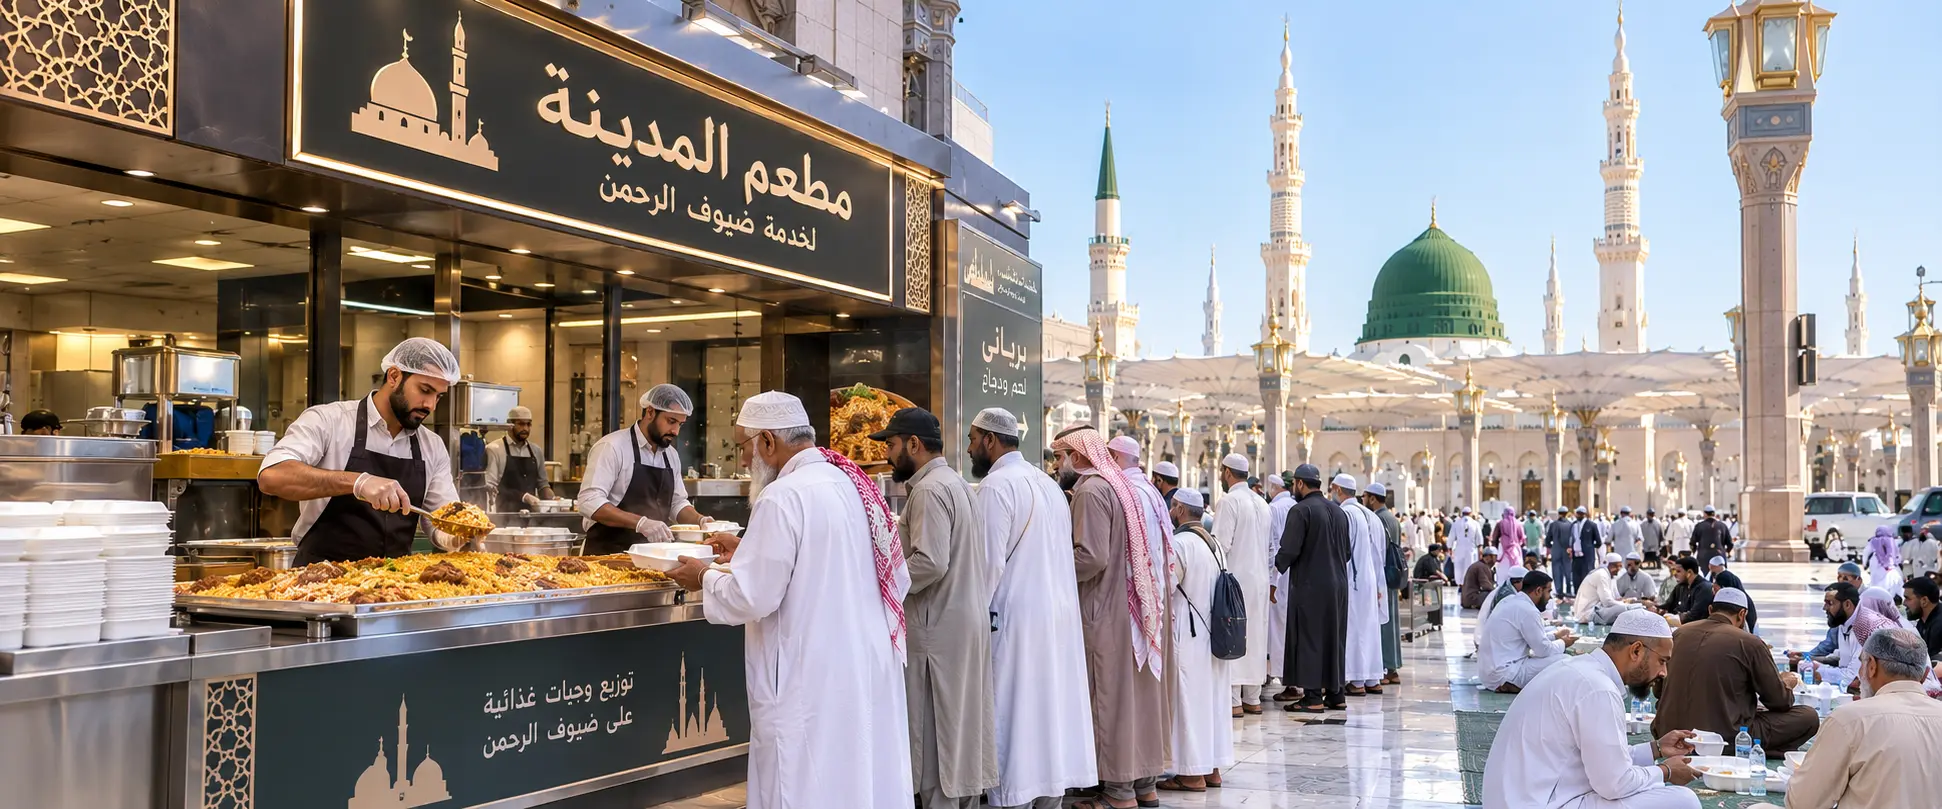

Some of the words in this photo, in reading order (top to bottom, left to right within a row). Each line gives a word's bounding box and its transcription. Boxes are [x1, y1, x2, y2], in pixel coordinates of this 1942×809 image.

[536, 62, 729, 180] المدينة
[599, 173, 676, 216] الرحمن
[744, 152, 853, 221] مطعم
[687, 195, 755, 237] ضيوف
[763, 214, 816, 252] لخدمة
[483, 686, 537, 719] غذائية
[599, 671, 634, 702] توزيع
[547, 713, 599, 743] ضيوف
[606, 705, 633, 734] على
[483, 721, 538, 759] الرحمن
